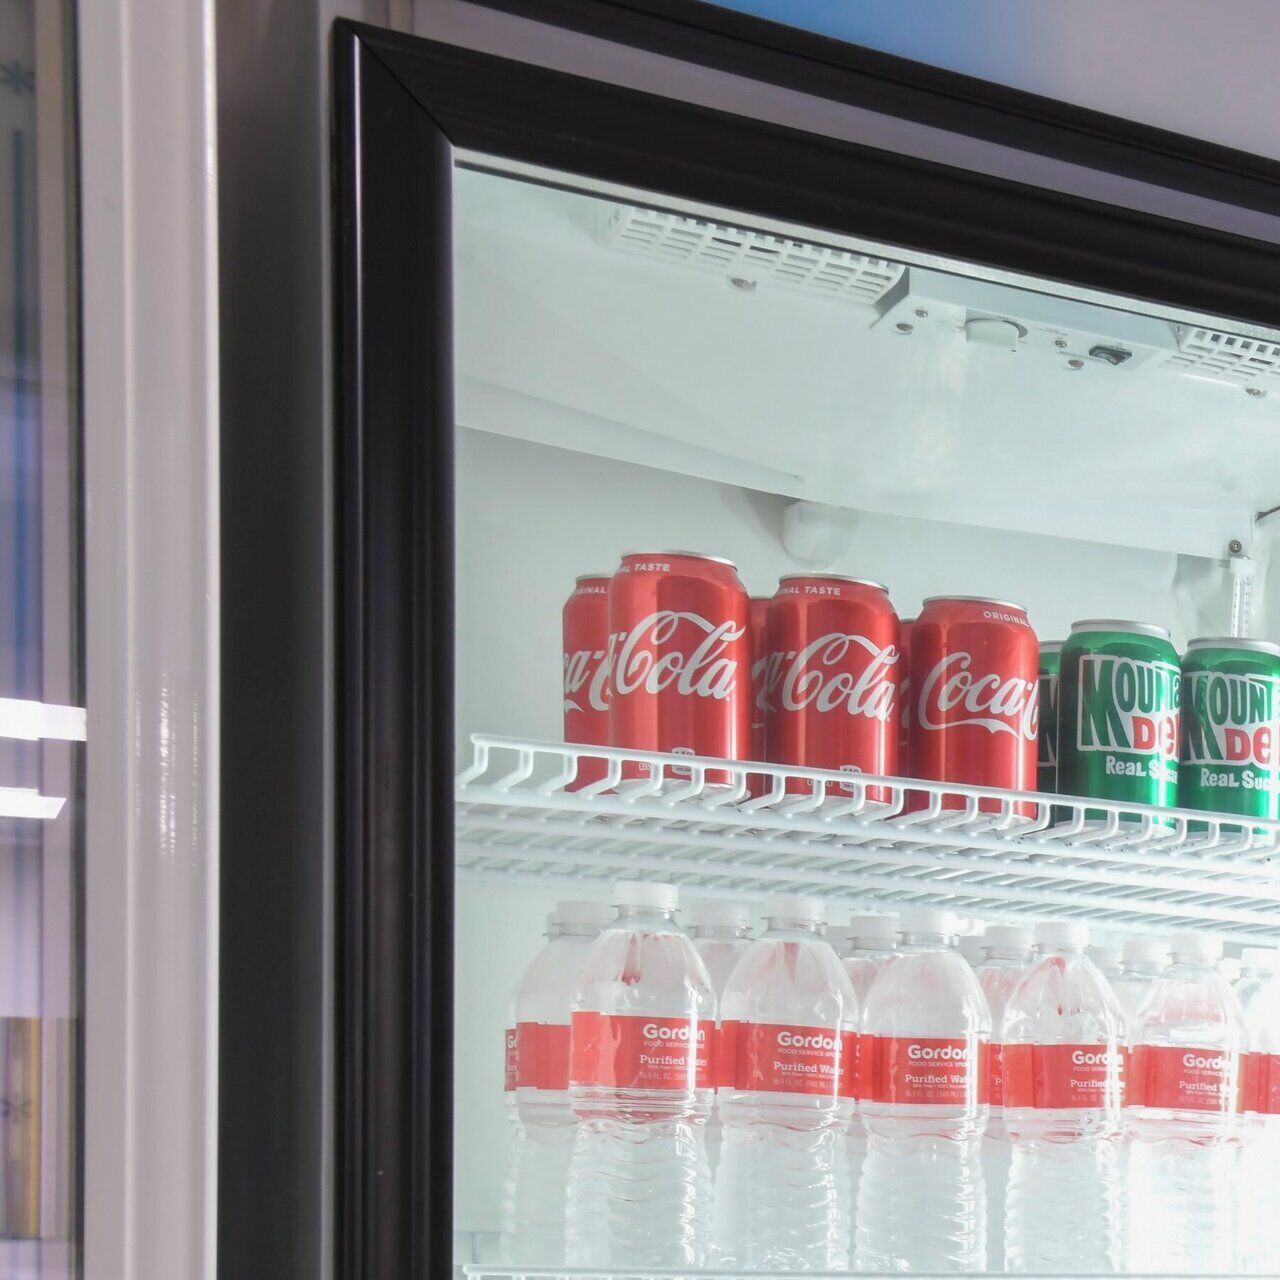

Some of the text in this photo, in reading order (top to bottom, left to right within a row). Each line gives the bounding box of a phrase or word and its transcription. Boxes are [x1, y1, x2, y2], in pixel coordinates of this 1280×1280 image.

[634, 562, 670, 572] TASTE
[804, 585, 841, 597] TASTE
[643, 1023, 706, 1041] Gordn
[777, 1031, 843, 1052] Gordon
[640, 1054, 685, 1066] Purified
[773, 1061, 818, 1073] Purified
[905, 1074, 948, 1084] Purified
[1179, 1080, 1218, 1091] Purified
